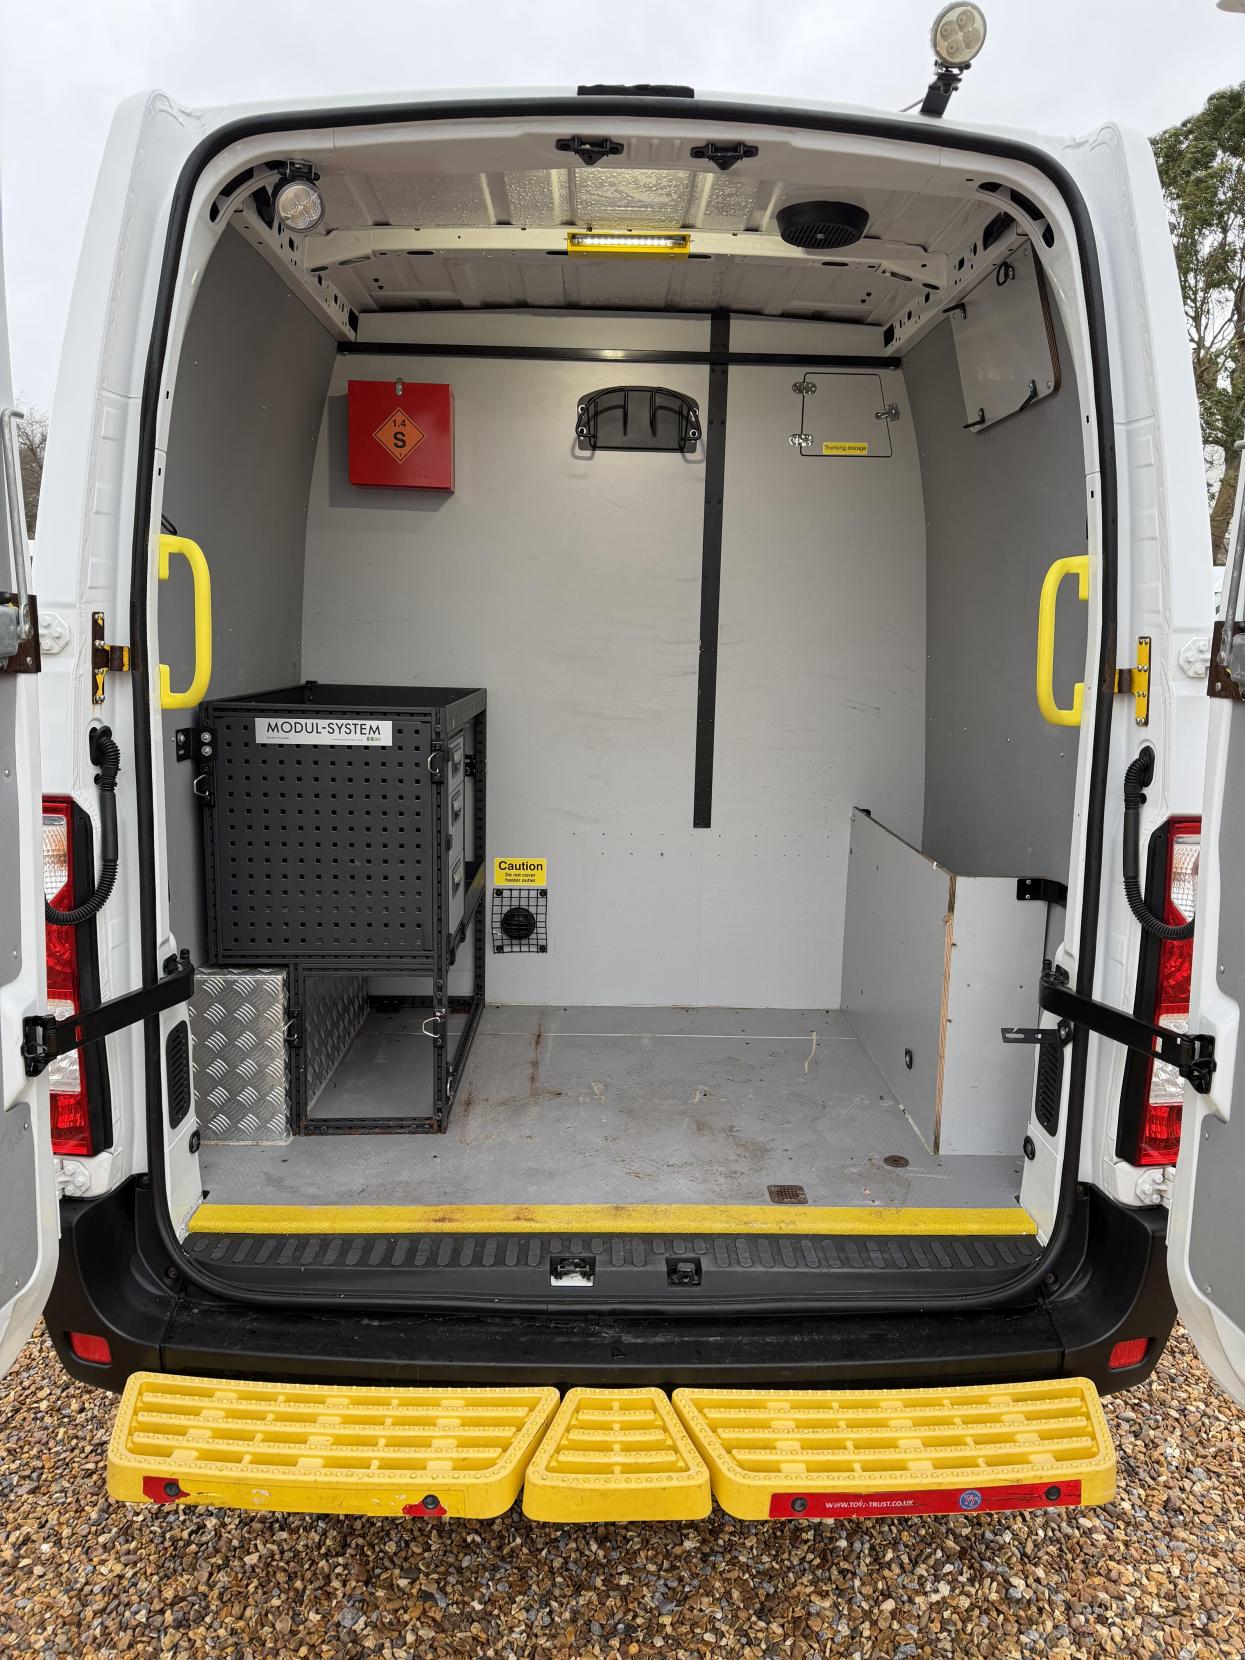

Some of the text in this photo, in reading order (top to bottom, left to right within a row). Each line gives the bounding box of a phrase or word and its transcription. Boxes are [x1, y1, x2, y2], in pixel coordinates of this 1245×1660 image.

[393, 431, 406, 449] S
[266, 721, 381, 735] MODUL-SYSTEM
[498, 860, 543, 871] Caution
